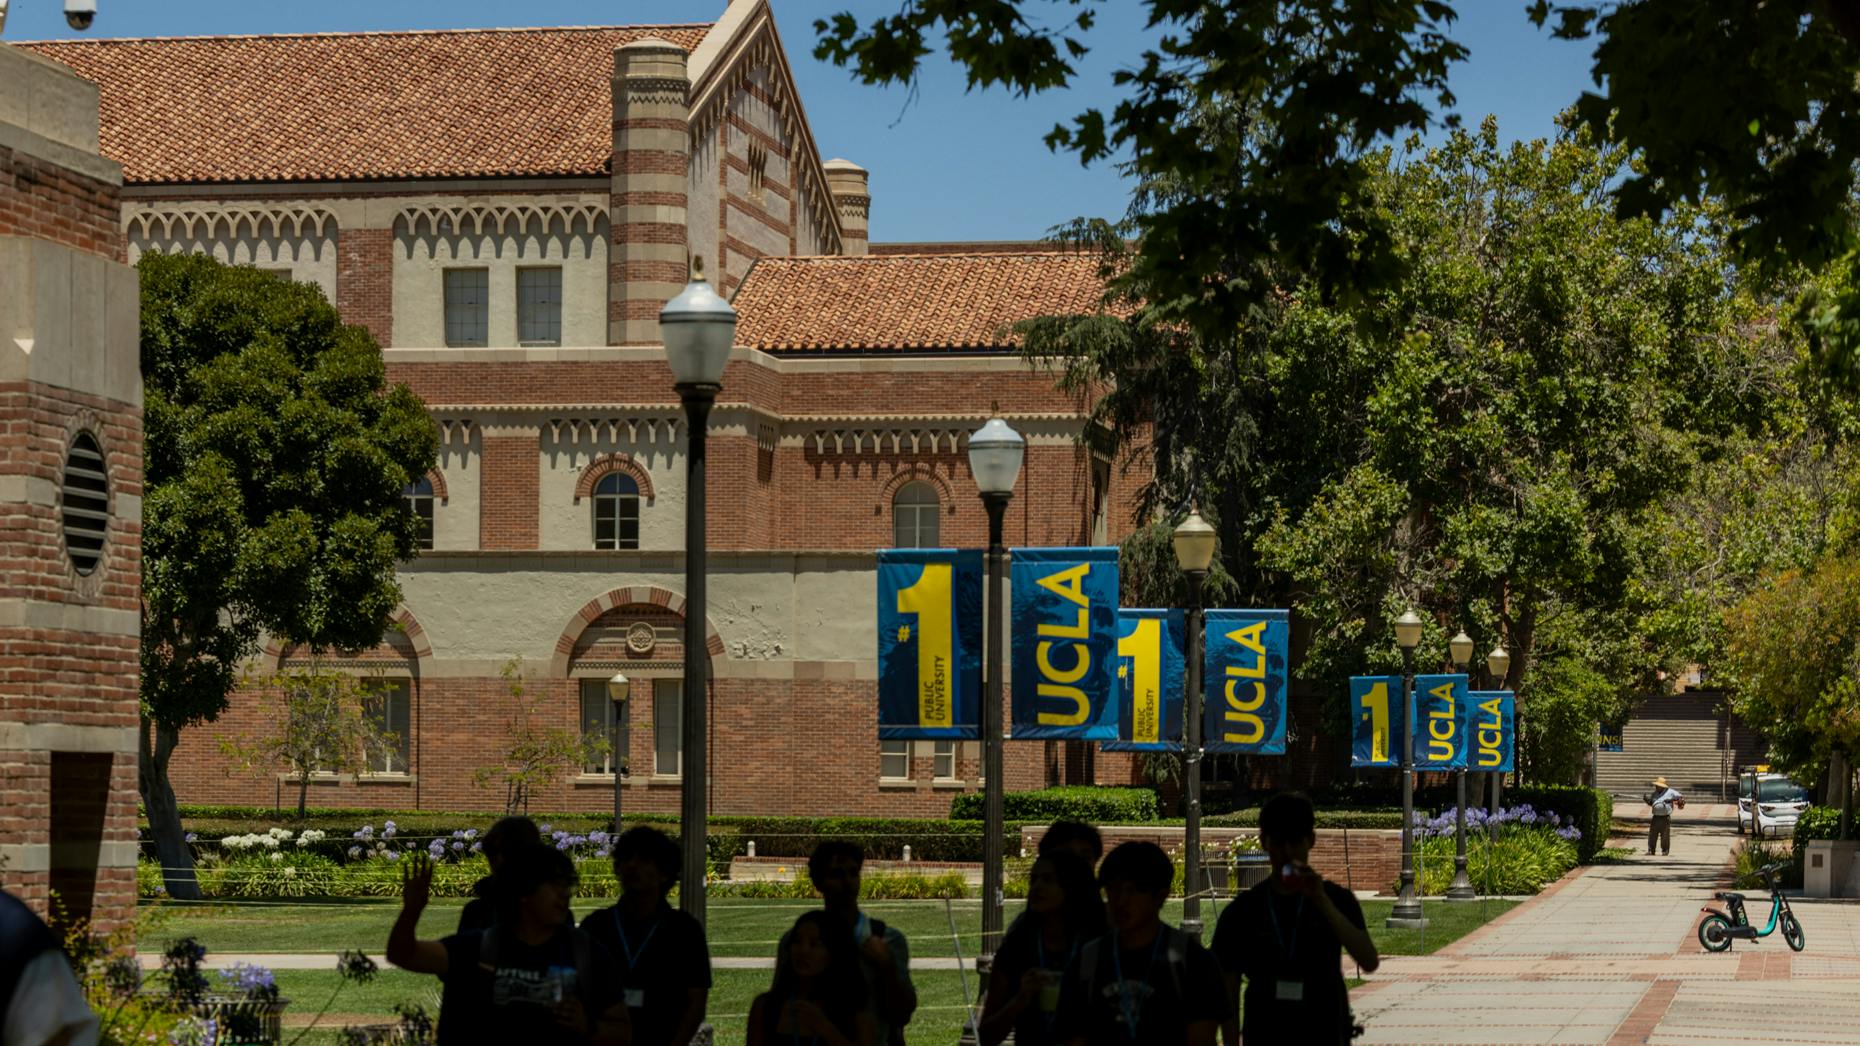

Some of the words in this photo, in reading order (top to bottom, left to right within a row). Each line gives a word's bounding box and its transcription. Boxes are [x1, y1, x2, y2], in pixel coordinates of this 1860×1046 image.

[1037, 563, 1091, 727] UCLA
[924, 681, 935, 721] PUBLIC
[934, 656, 946, 721] UNIVERSITY
[1145, 688, 1155, 738] UNIVERSITY
[1224, 621, 1267, 744] UCLA
[1137, 707, 1147, 737] PUBLIC
[1428, 683, 1455, 761] UCLA
[1478, 698, 1502, 767] UCLA
